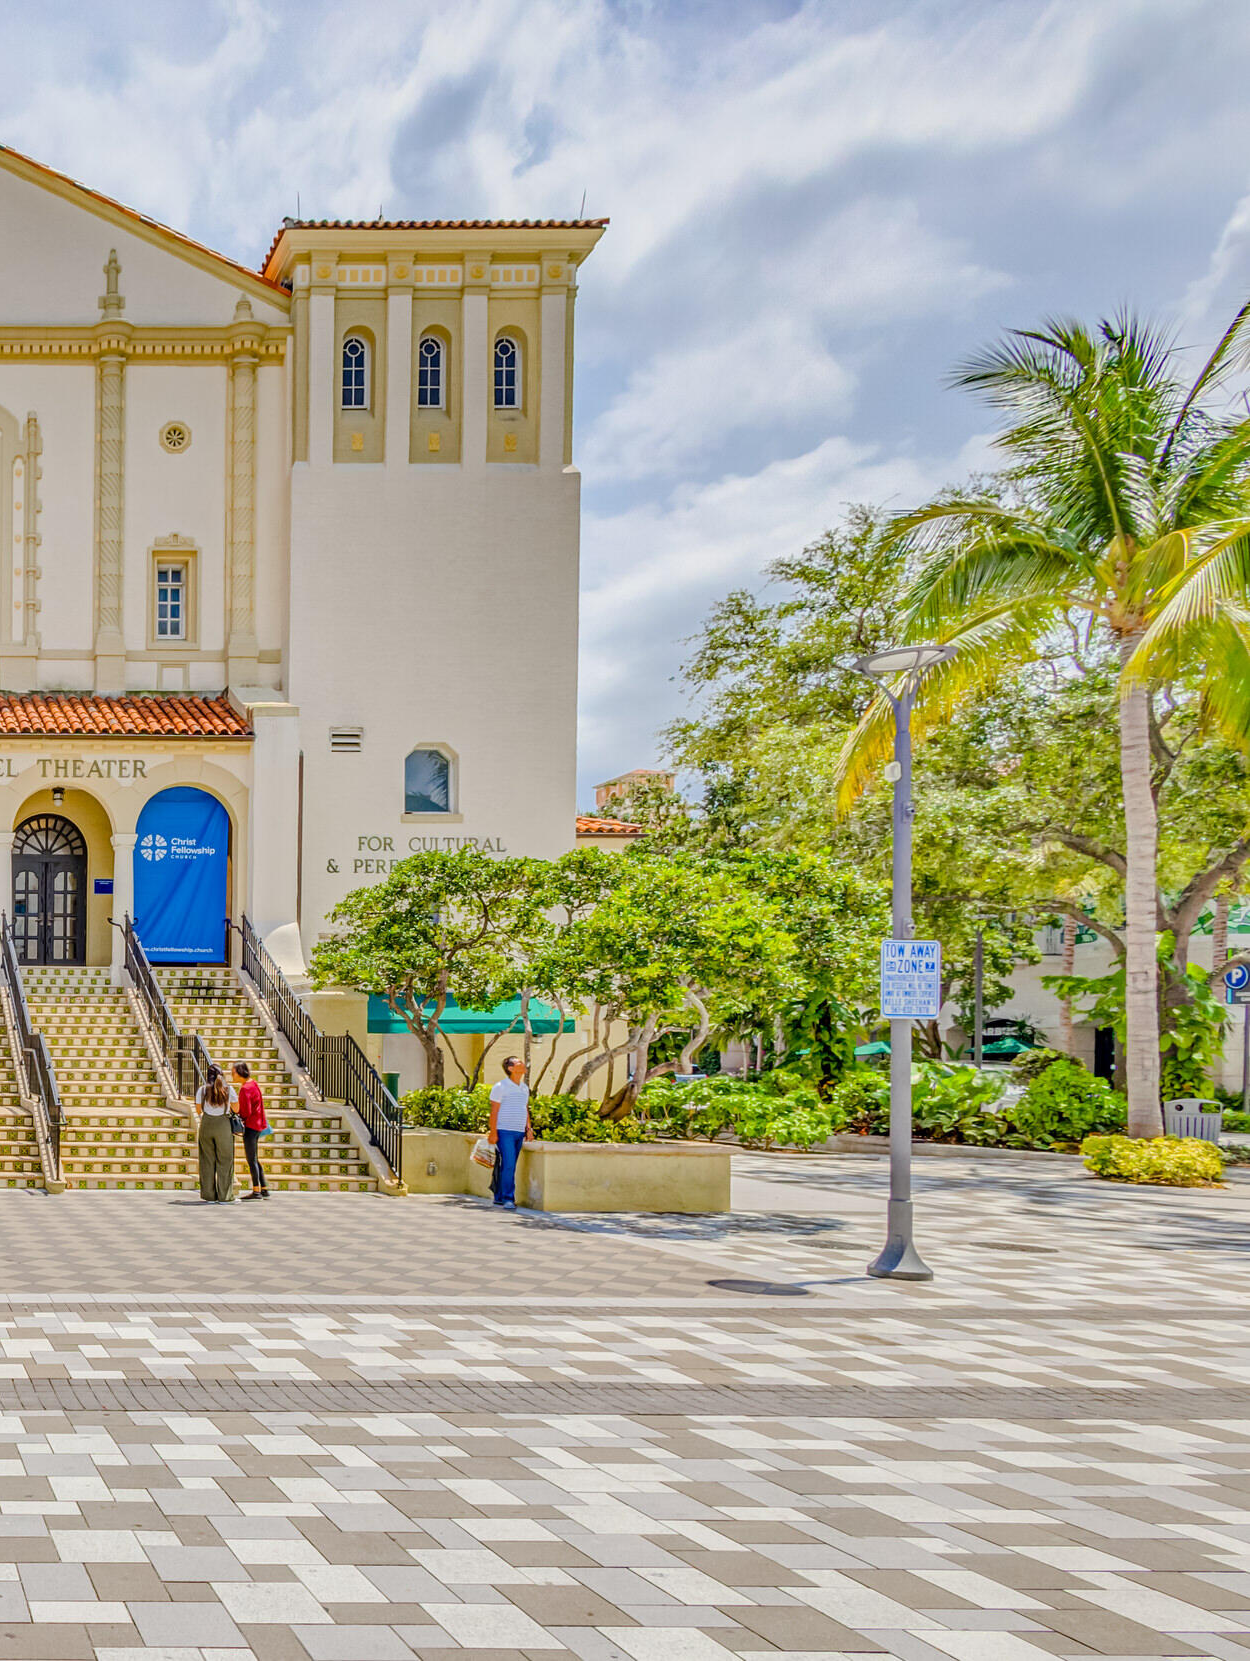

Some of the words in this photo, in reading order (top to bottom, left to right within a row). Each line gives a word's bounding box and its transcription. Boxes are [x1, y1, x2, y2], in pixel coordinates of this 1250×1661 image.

[36, 759, 148, 779] THEATER
[171, 838, 197, 846] Christ
[357, 836, 395, 852] FOR
[408, 837, 508, 852] CULTURAL
[171, 846, 216, 856] Fellowship
[326, 858, 340, 874] &
[885, 944, 906, 958] TOW
[910, 945, 936, 958] AWAY
[897, 959, 924, 974] ZONE
